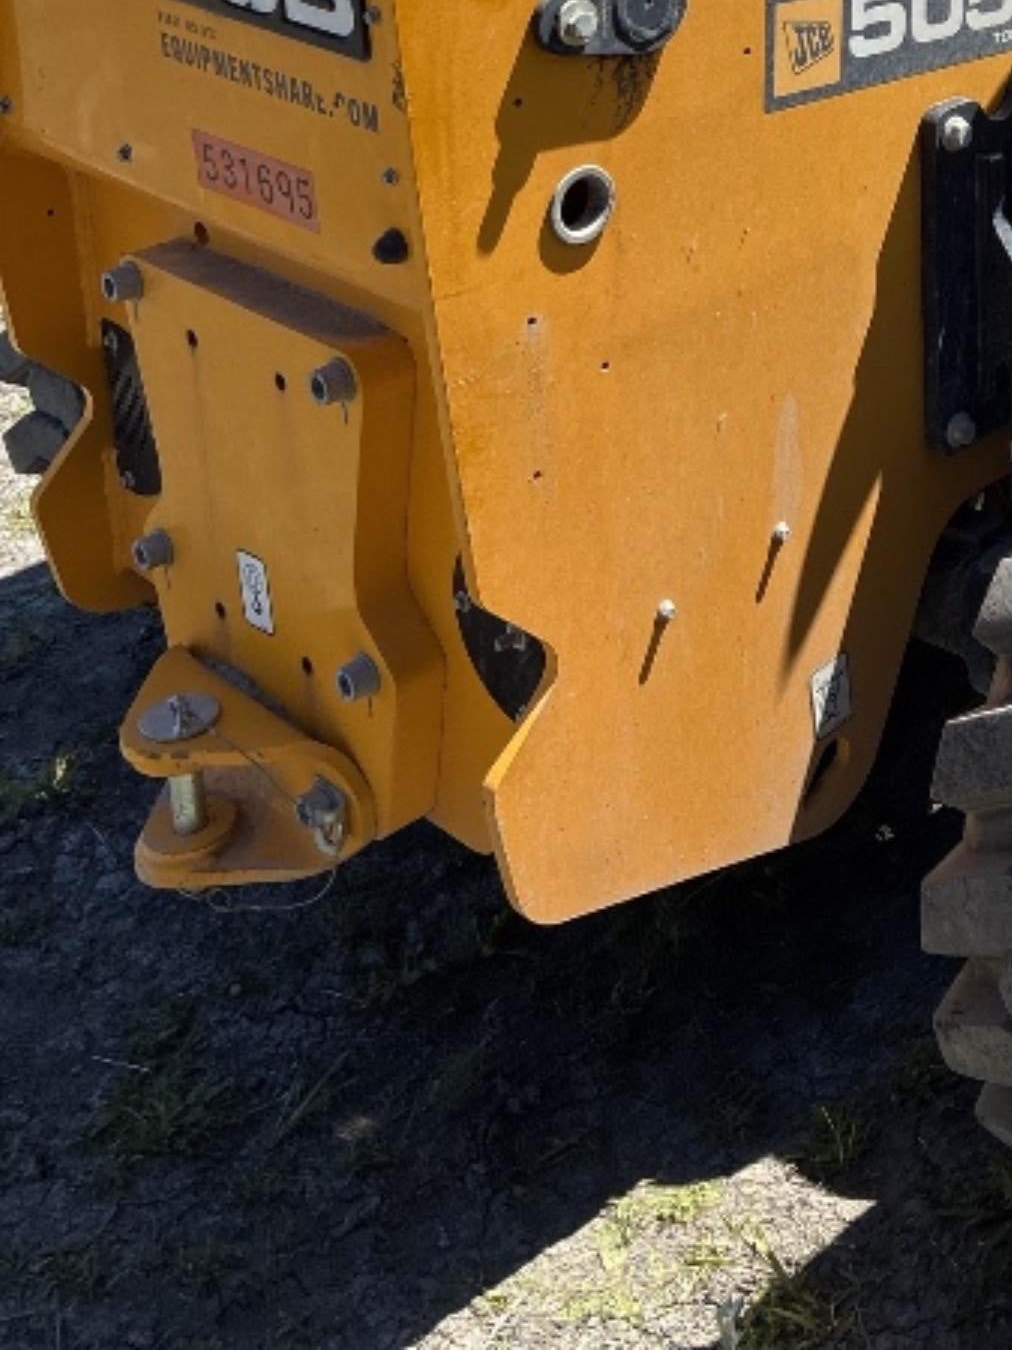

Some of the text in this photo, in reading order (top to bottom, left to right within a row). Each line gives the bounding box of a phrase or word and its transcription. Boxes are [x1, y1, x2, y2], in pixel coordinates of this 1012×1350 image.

[160, 33, 379, 132] EQUIPMENTSHARE.COM
[793, 24, 831, 67] JCB
[203, 143, 312, 219] 531695
